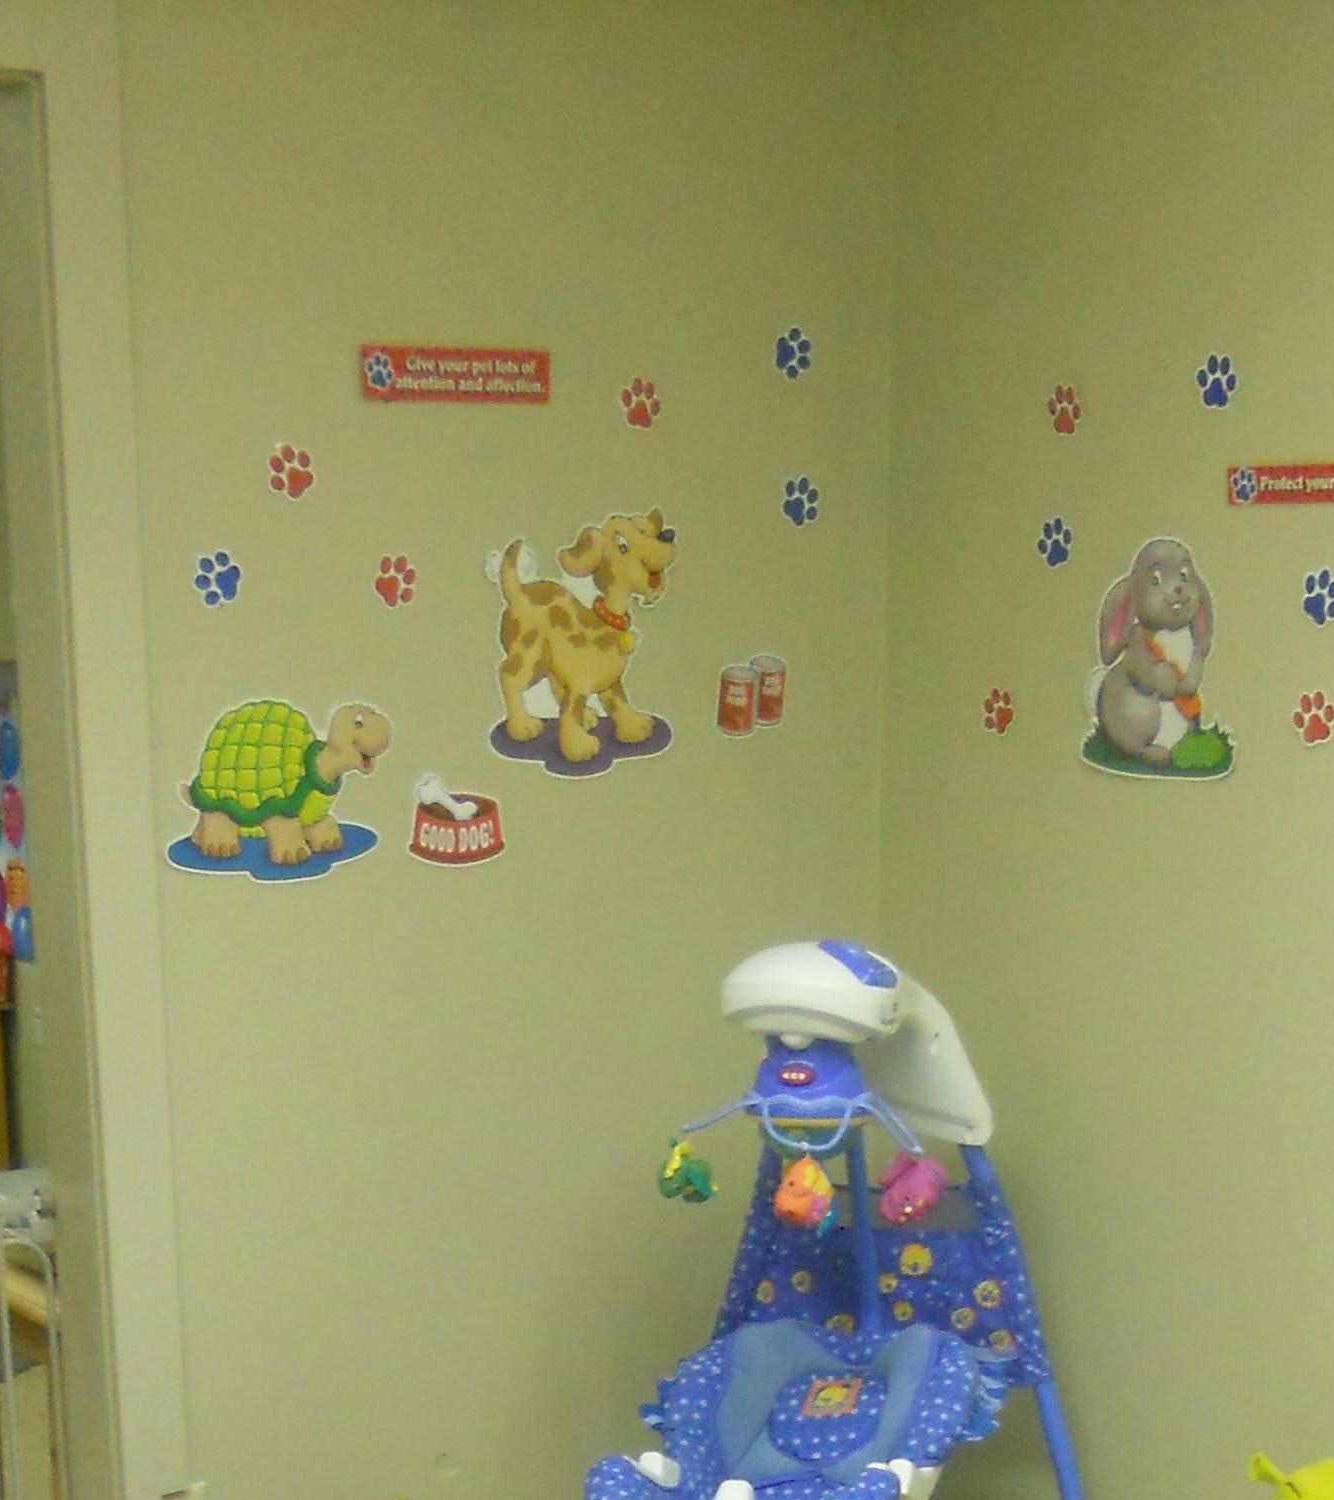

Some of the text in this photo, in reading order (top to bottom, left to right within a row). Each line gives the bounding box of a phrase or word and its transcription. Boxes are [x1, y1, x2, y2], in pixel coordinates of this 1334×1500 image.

[406, 356, 436, 371] Give
[438, 359, 469, 375] your
[457, 377, 483, 391] and
[1260, 476, 1304, 491] Protect
[420, 819, 495, 853] GOOD DOG!
